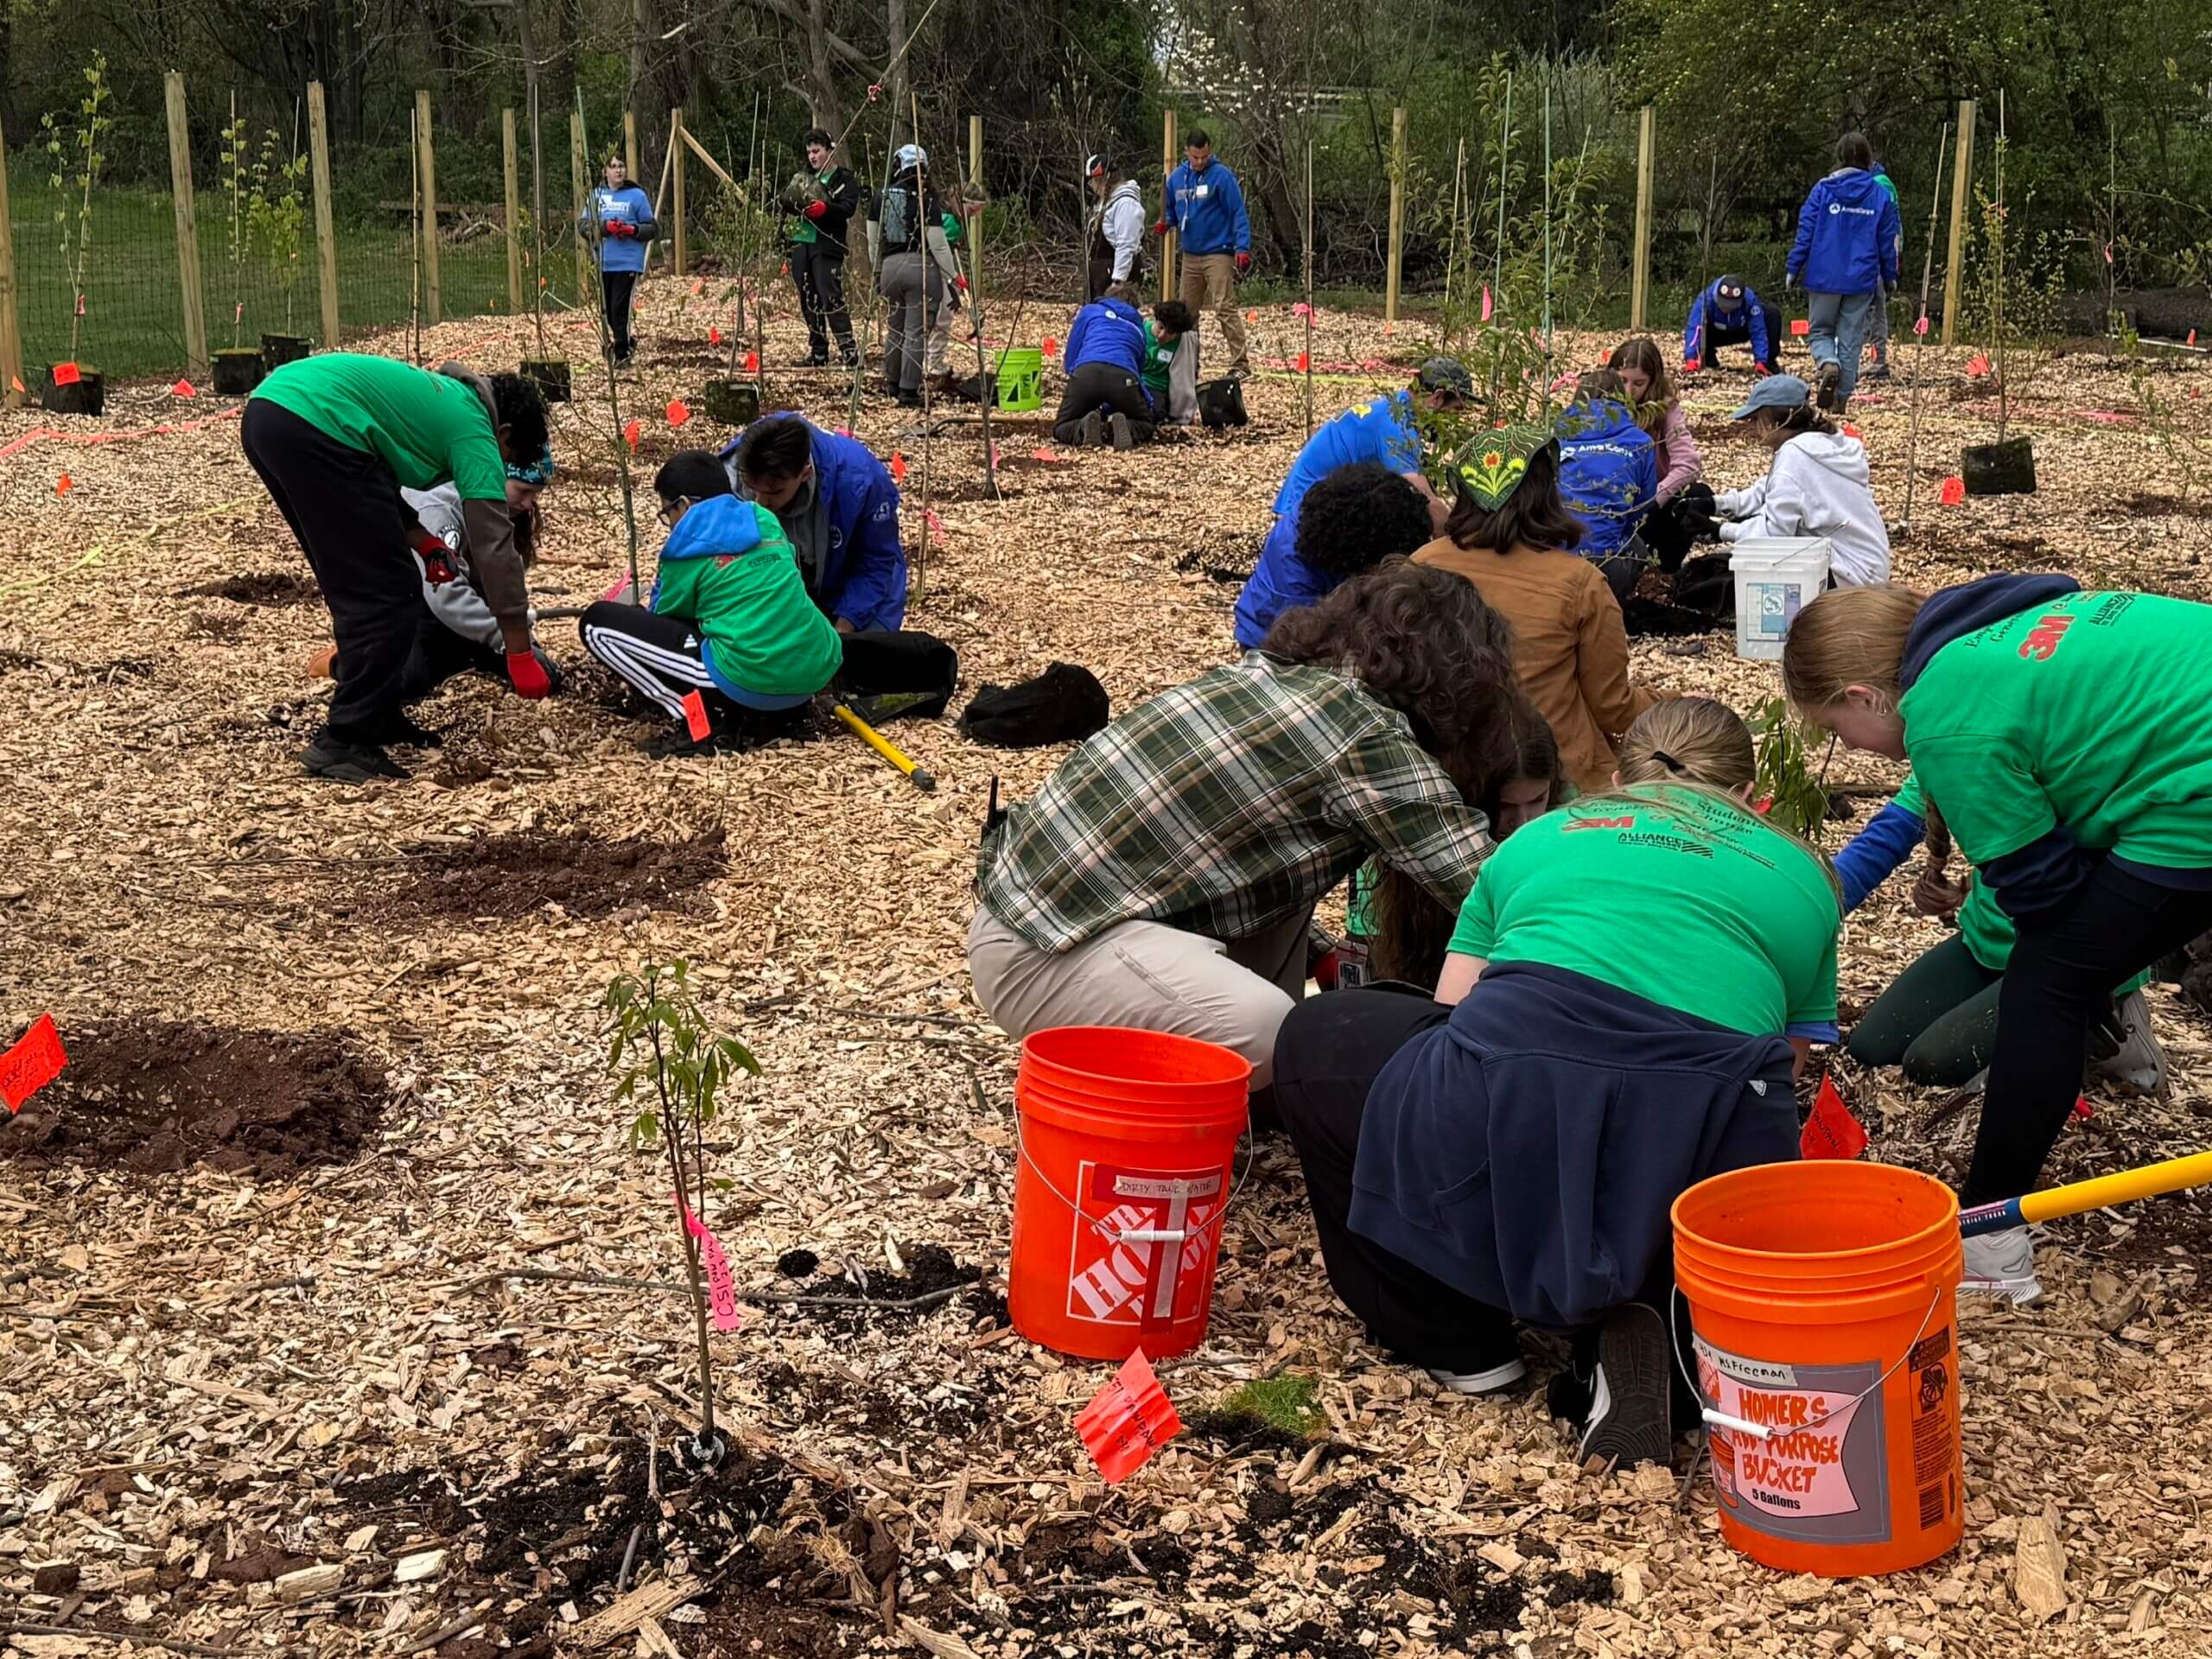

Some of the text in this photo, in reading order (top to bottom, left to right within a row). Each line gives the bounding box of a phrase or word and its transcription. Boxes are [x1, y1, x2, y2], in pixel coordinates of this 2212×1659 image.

[2018, 614, 2075, 662] 3M
[1561, 815, 1636, 833] 3M
[716, 1284, 734, 1317] CSI
[1738, 1388, 1830, 1429] HOMER'S
[1742, 1452, 1818, 1494] BUCKET
[1751, 1488, 1802, 1510] 5 Gallons
